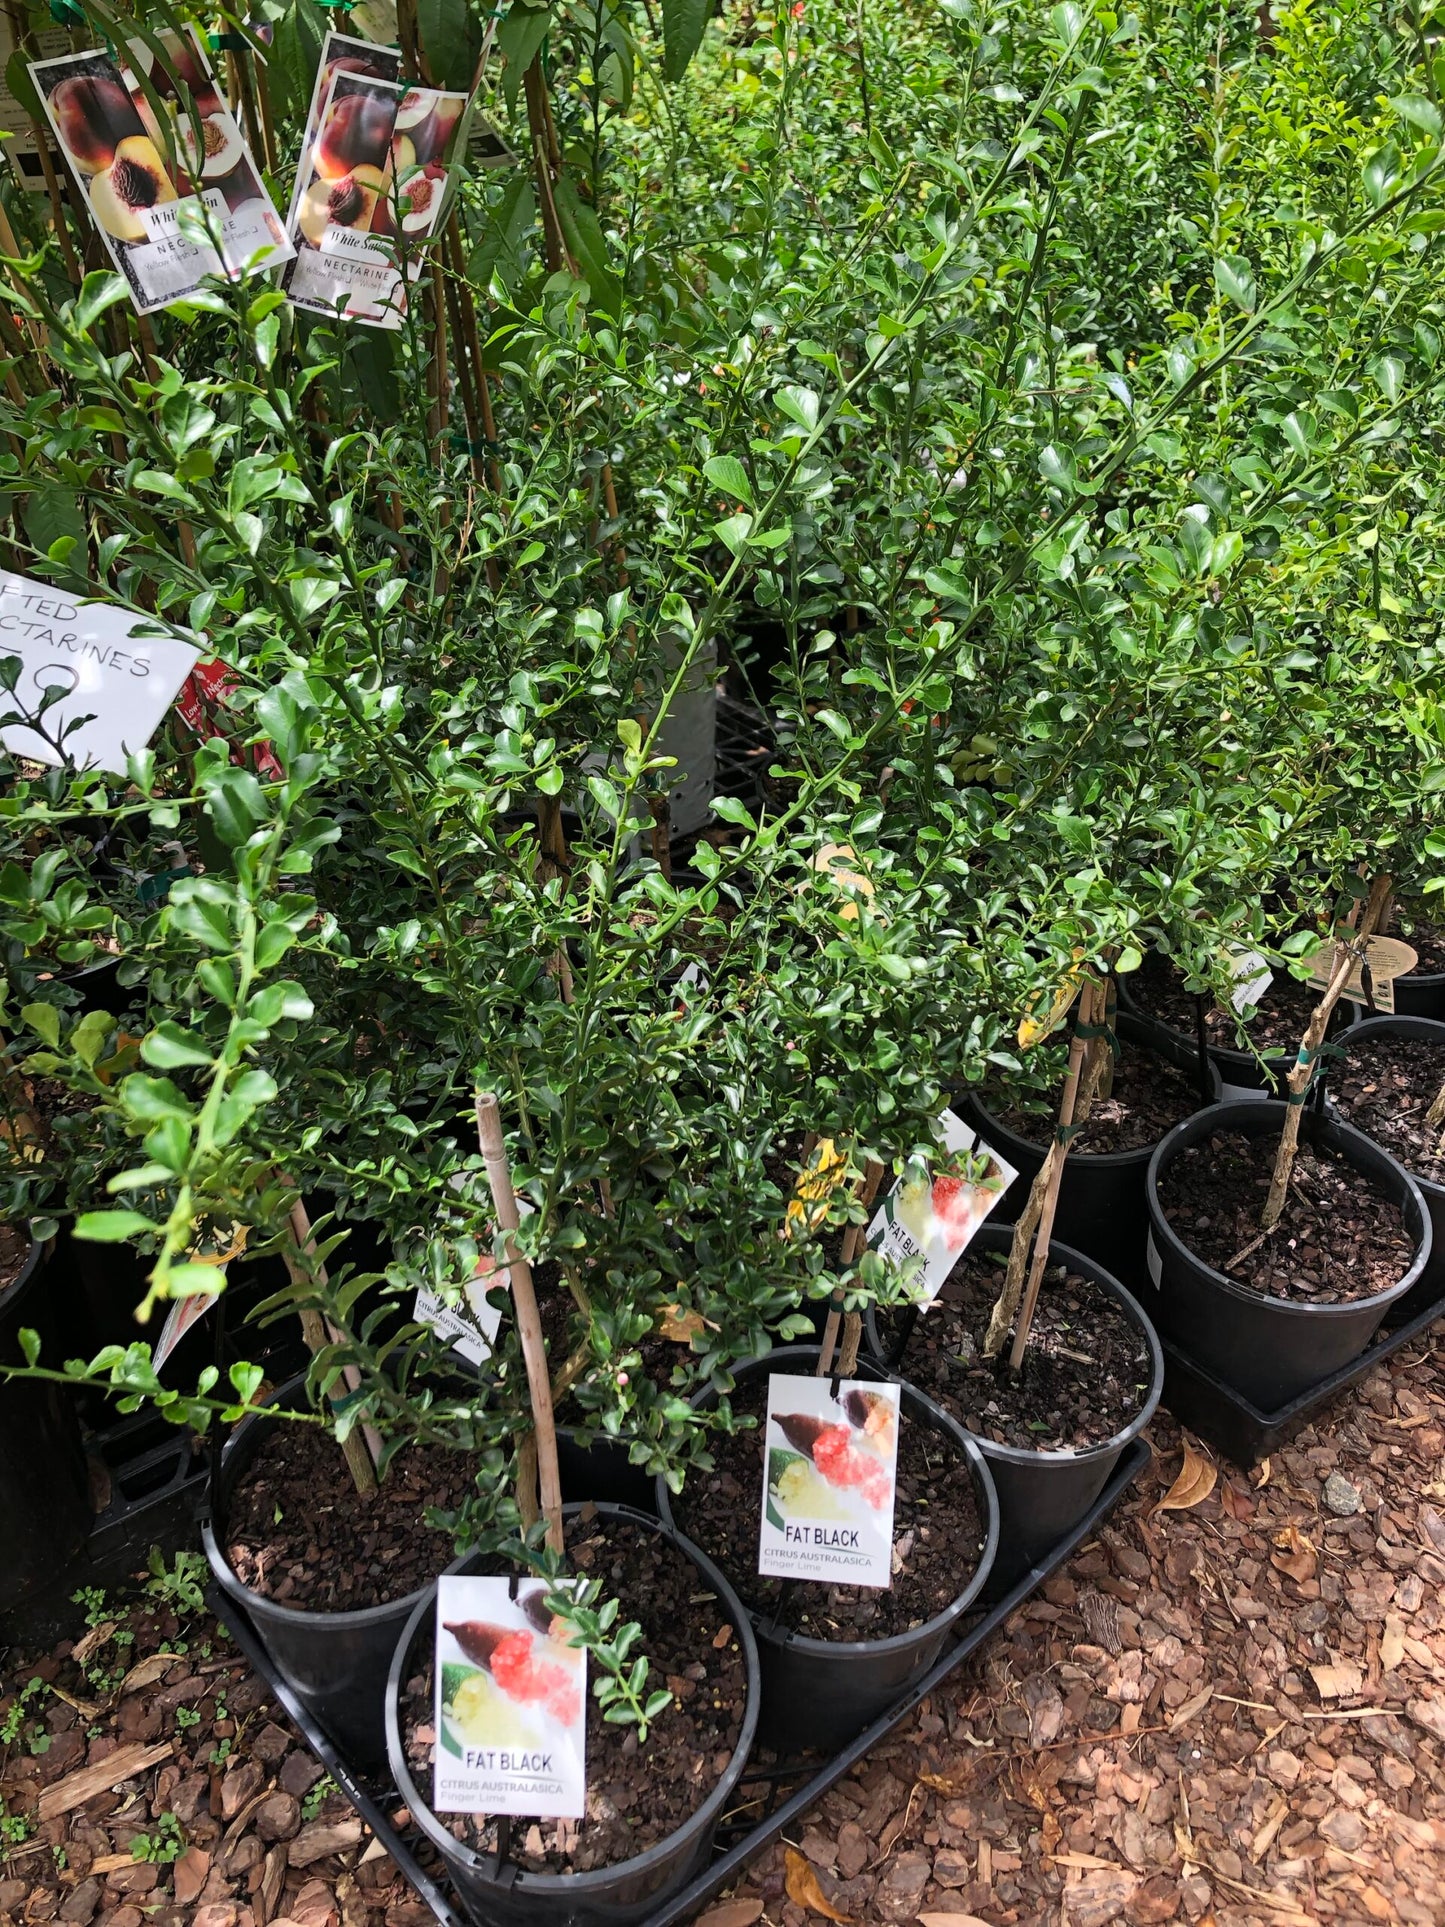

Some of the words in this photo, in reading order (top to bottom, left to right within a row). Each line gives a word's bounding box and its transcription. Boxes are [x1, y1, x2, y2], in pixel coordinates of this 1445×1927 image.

[157, 220, 237, 254] NECNE
[331, 230, 361, 248] White
[324, 258, 390, 281] NECTARINE
[888, 1220, 906, 1242] FAT
[902, 1237, 931, 1272] BLAK
[785, 1525, 811, 1544] FAT
[814, 1528, 859, 1548] BLACK
[763, 1559, 795, 1570] Finger
[797, 1562, 822, 1572] Lime
[764, 1548, 799, 1559] CITRUS
[800, 1551, 872, 1567] AUSTRALASICA
[466, 1751, 496, 1770] FAT
[500, 1752, 553, 1773] BLACK
[440, 1779, 479, 1790] CITRUS
[481, 1781, 564, 1794] AUSTRALASICA
[440, 1791, 476, 1803] Finger
[479, 1793, 506, 1803] Lime
